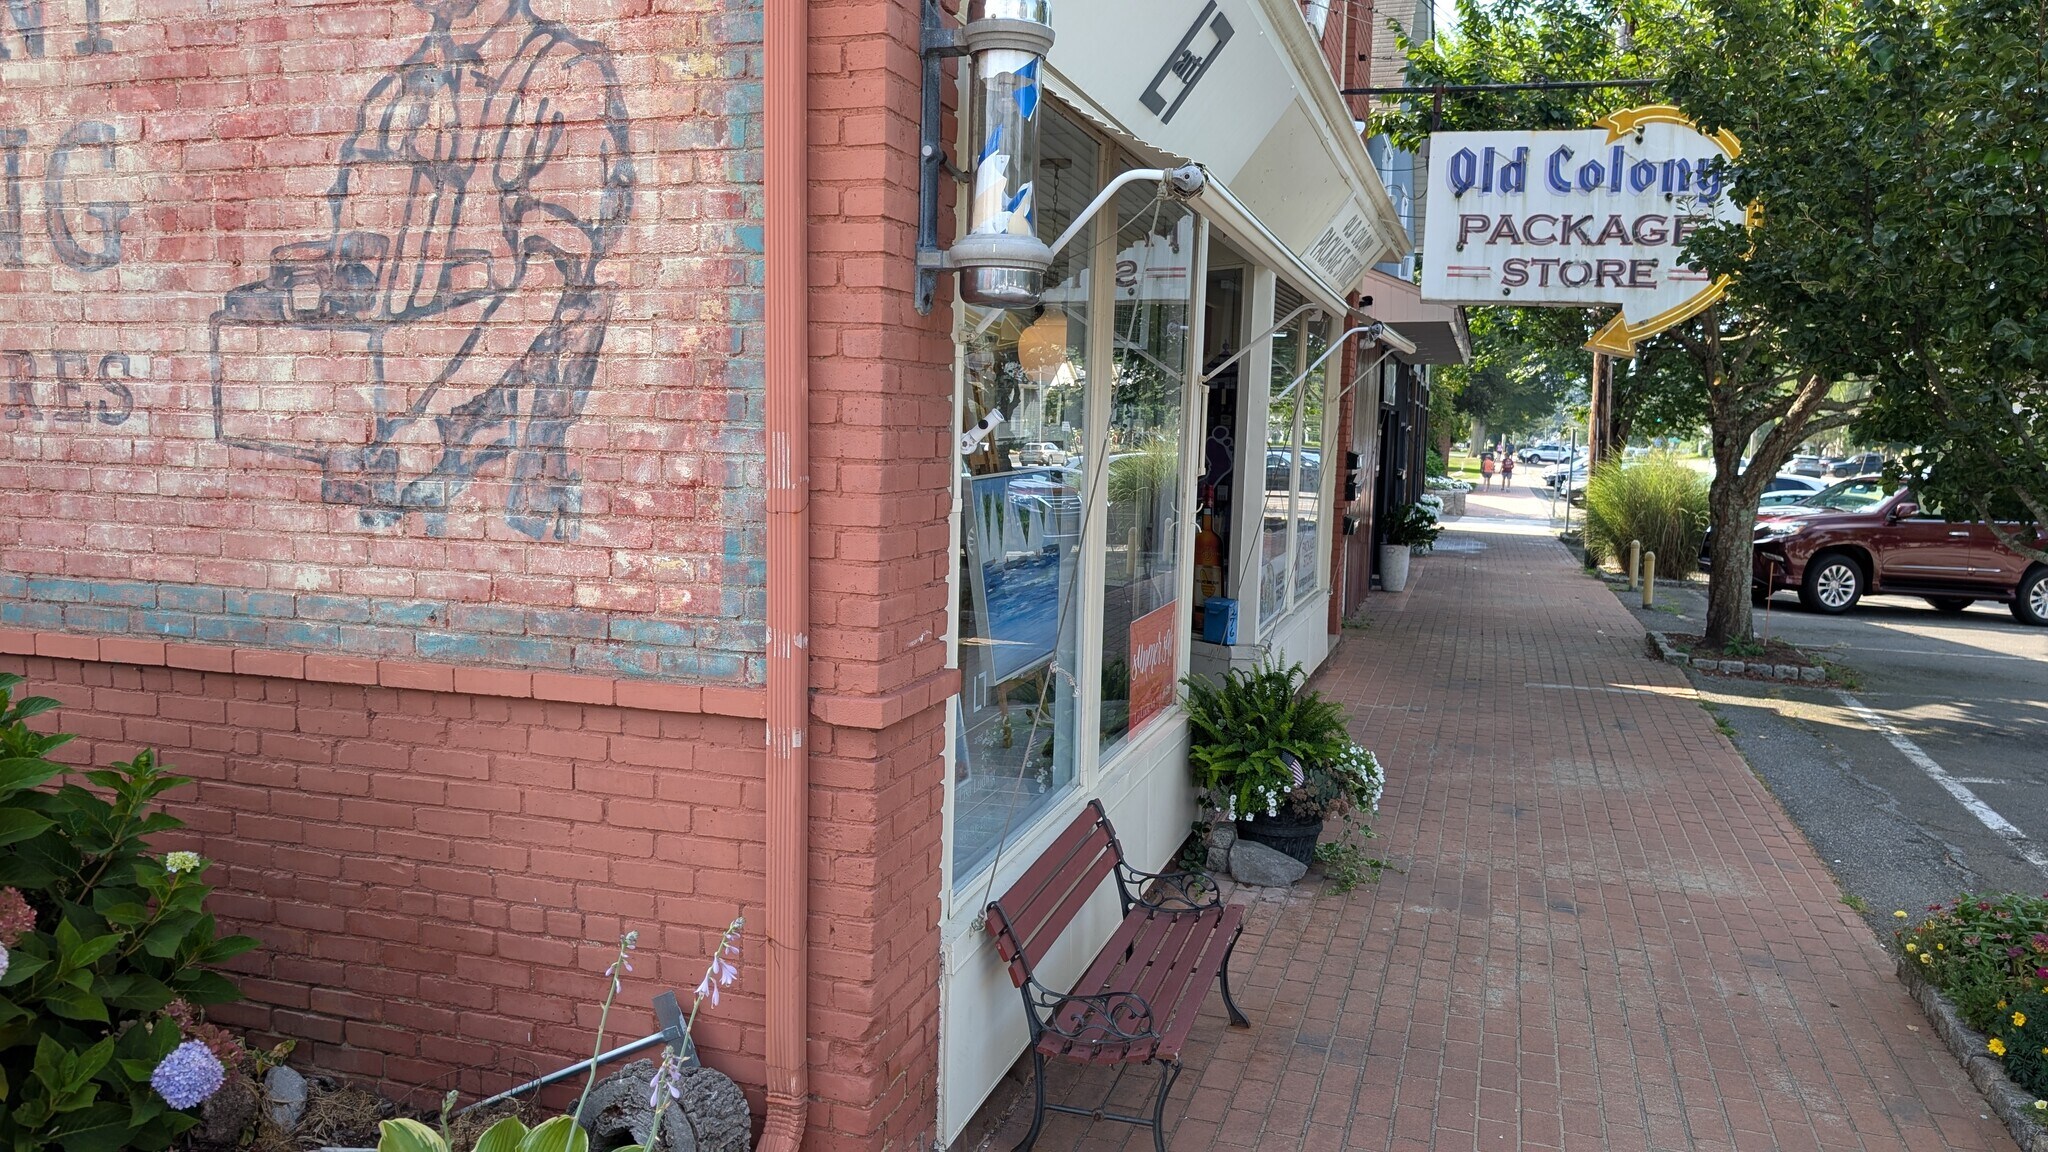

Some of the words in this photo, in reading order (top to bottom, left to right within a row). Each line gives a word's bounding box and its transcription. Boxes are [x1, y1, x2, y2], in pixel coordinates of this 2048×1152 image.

[1447, 147, 1529, 196] Old
[1546, 144, 1721, 206] Colony
[1342, 213, 1363, 239] OLD
[1351, 226, 1374, 256] COLONY
[1457, 214, 1707, 247] PACKAGE
[1309, 226, 1352, 275] PACKAGE
[1333, 253, 1363, 288] STORE
[1501, 257, 1660, 290] STORE
